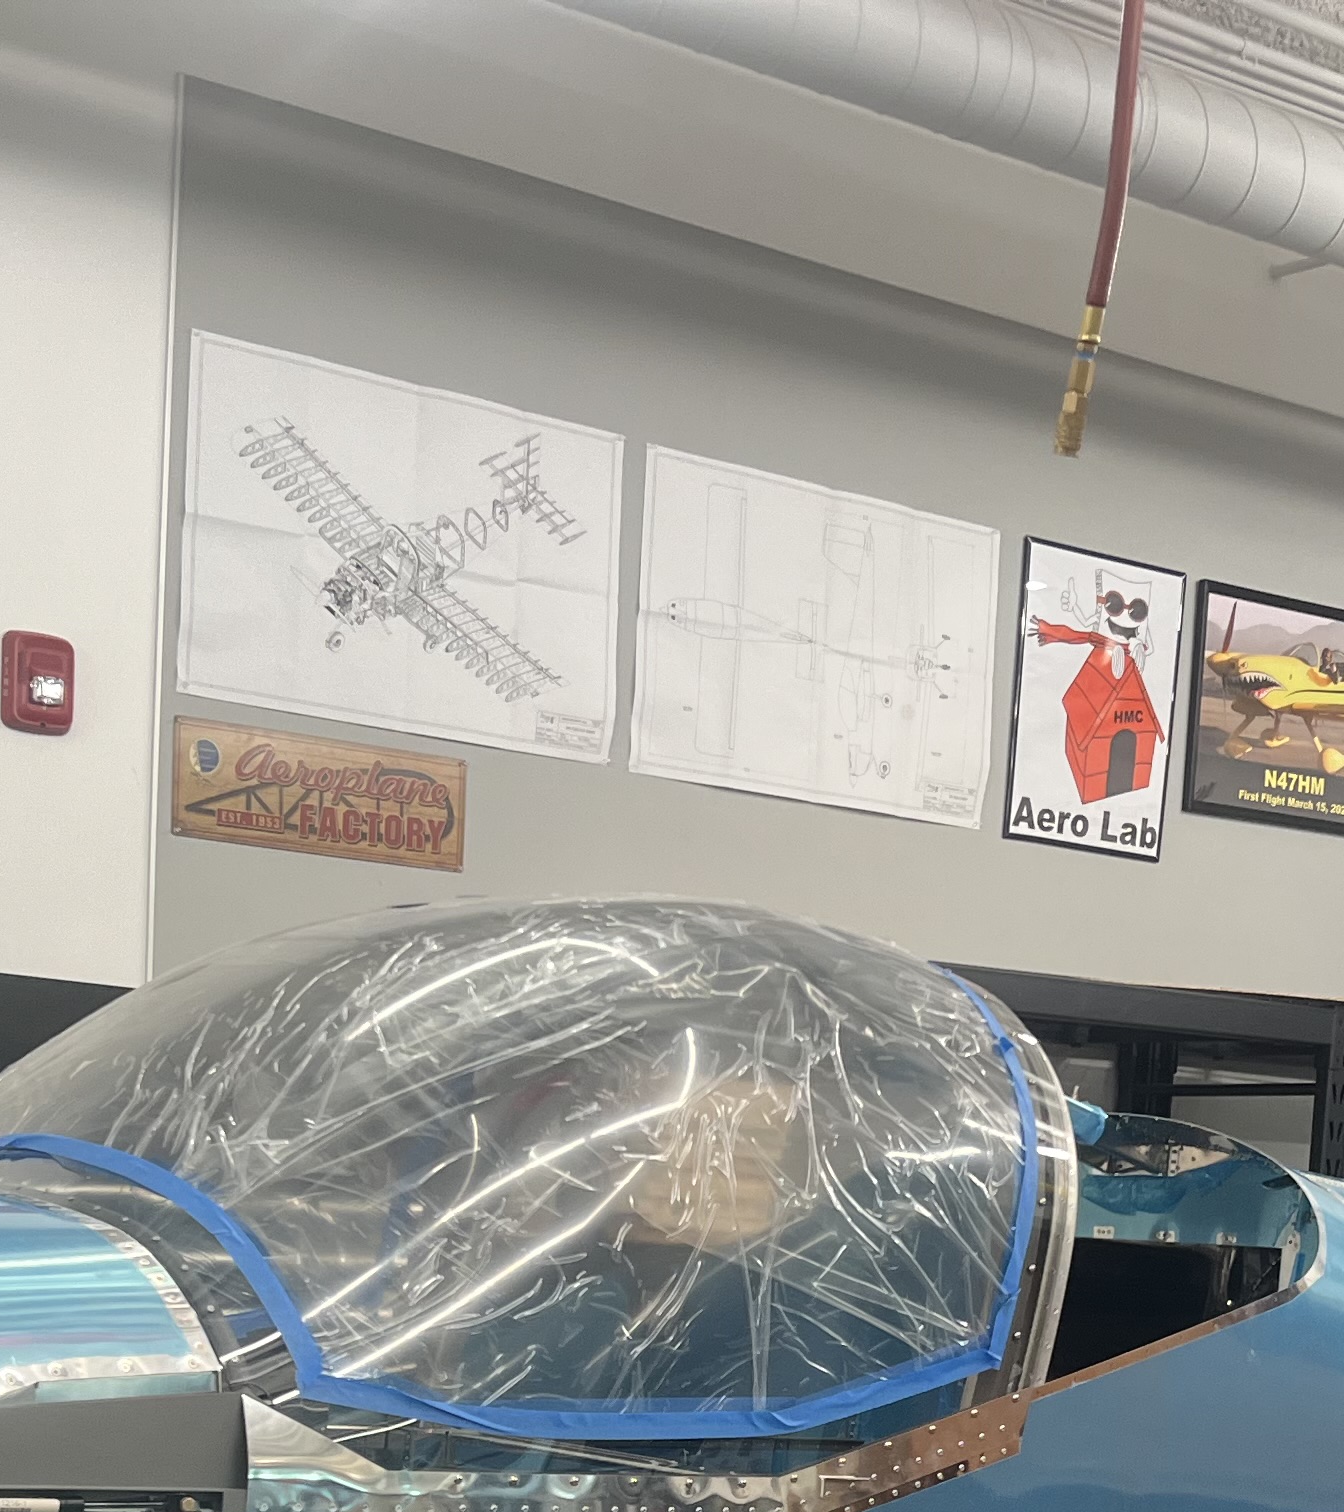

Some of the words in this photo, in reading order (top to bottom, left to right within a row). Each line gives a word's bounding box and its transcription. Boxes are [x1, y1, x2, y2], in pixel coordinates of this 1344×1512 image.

[1114, 711, 1143, 724] HMC
[234, 743, 450, 808] Aeroplane
[1264, 769, 1325, 796] N47HM
[1238, 789, 1260, 803] First
[1261, 792, 1286, 807] Flight
[1287, 797, 1313, 811] March
[1315, 801, 1328, 815] 15,
[220, 809, 248, 826] EST.
[252, 813, 281, 829] 1953
[298, 803, 447, 854] FACTORY
[1012, 796, 1089, 838] Aero
[1100, 811, 1157, 849] Lab
